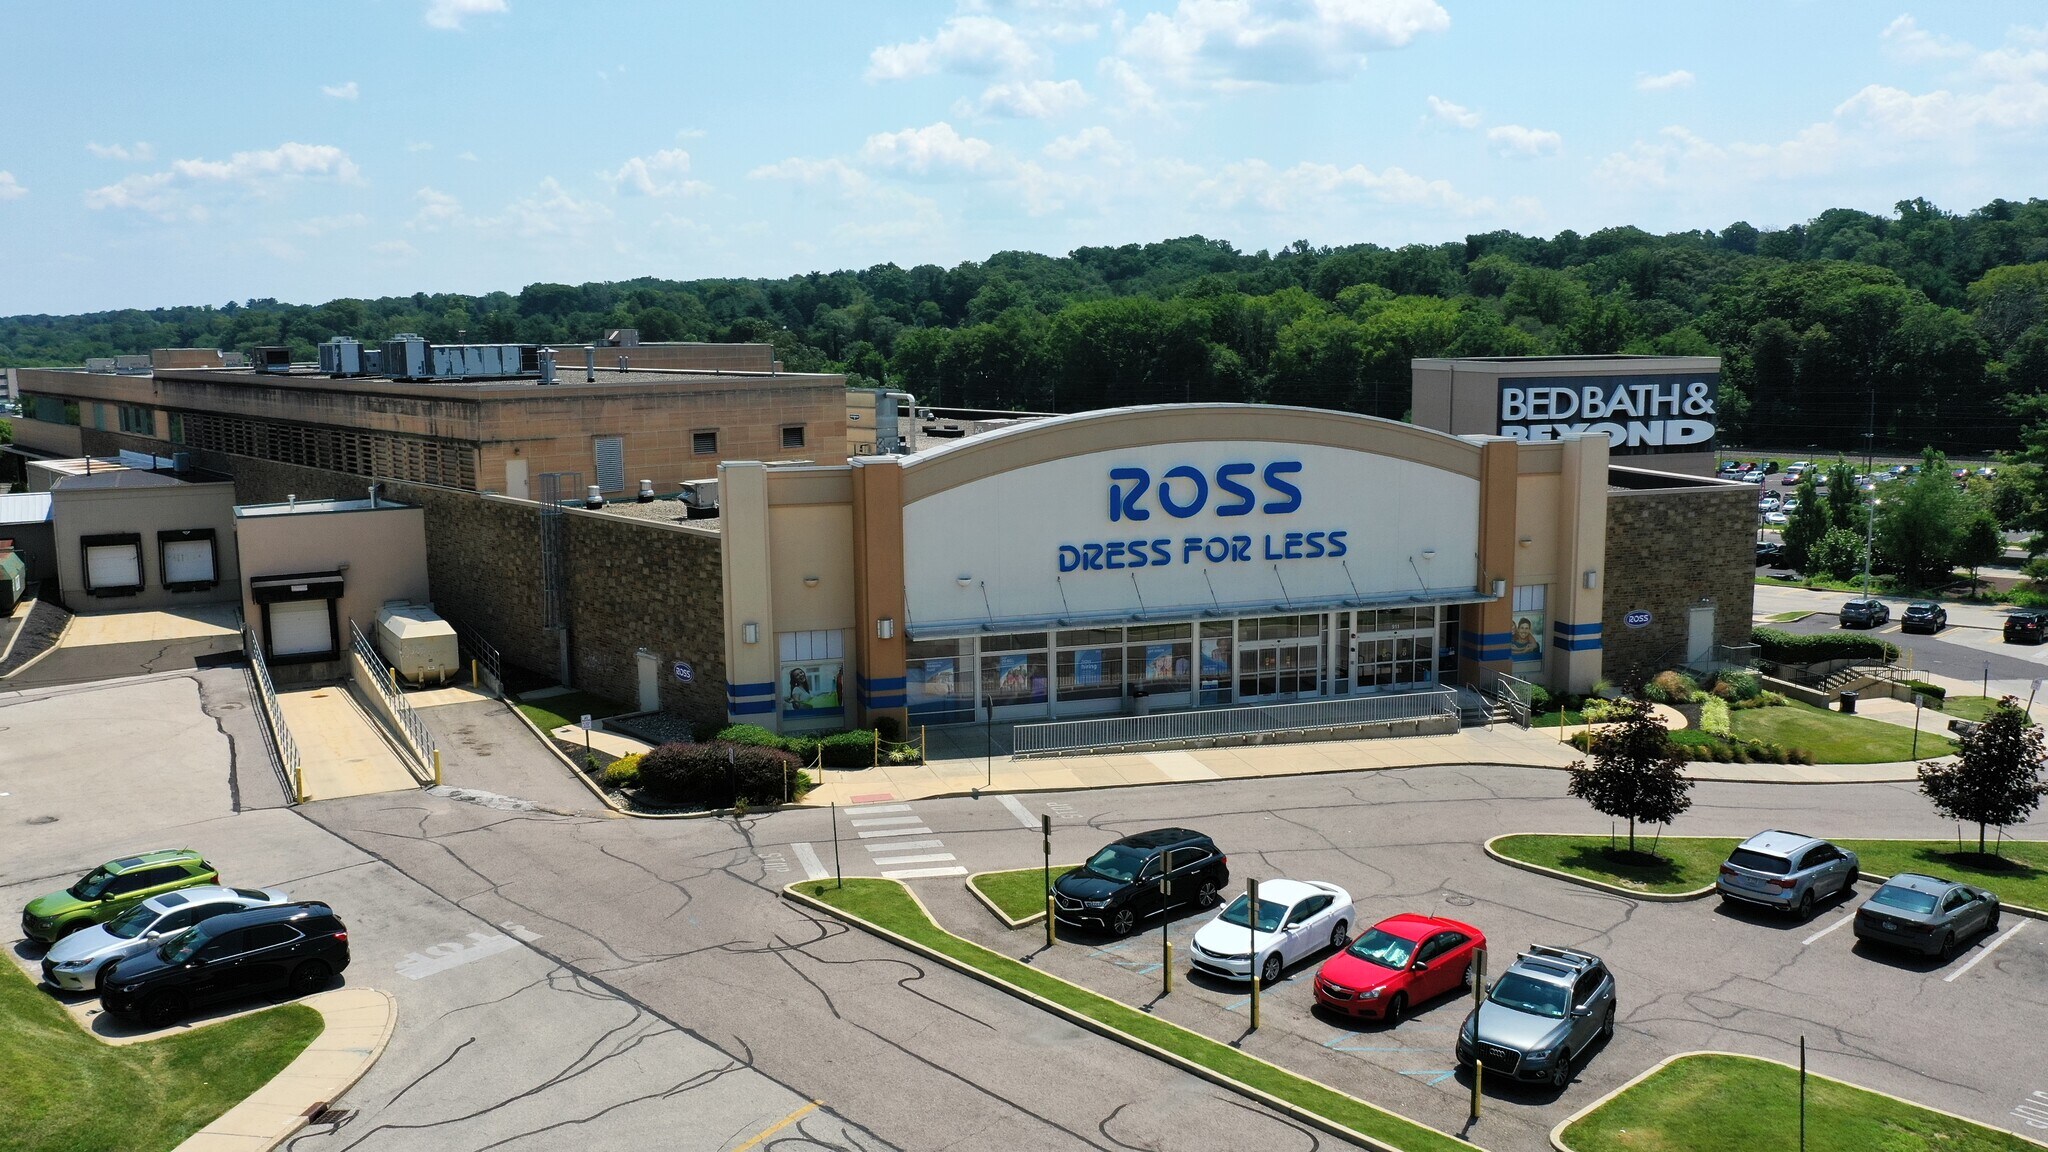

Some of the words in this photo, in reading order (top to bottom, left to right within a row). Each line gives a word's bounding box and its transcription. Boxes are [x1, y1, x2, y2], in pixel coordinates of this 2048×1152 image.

[1502, 386, 1579, 421] BED
[1581, 383, 1680, 419] BATH
[1682, 382, 1716, 416] &
[1109, 461, 1302, 522] ROSS
[1059, 539, 1172, 572] DRESS
[1183, 535, 1251, 564] FOR
[1265, 531, 1347, 561] LESS
[1628, 614, 1649, 623] ROSS
[675, 666, 691, 679] ROSS
[757, 852, 790, 873] STOP
